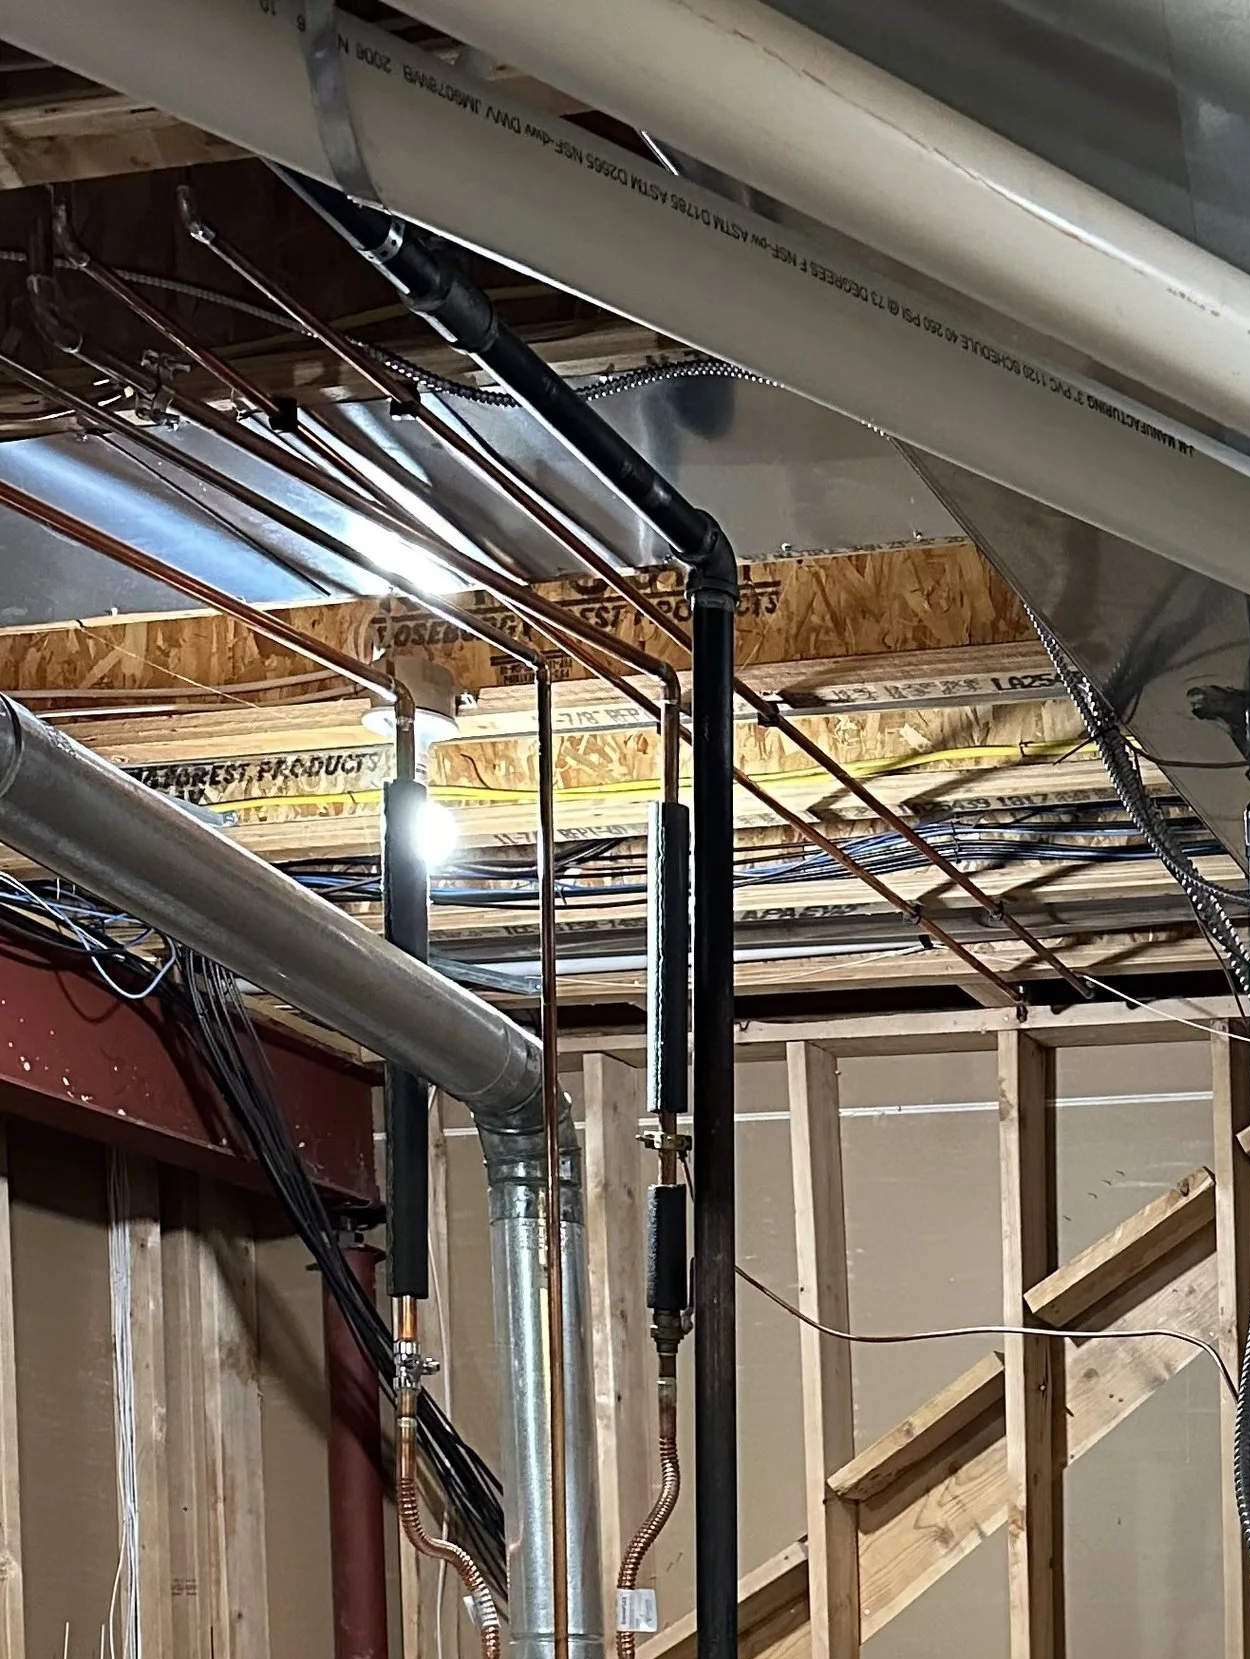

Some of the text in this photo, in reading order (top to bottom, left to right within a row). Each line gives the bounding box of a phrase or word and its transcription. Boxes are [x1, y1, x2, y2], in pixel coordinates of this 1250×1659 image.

[486, 105, 521, 135] DWV
[586, 154, 629, 186] D2665
[630, 173, 668, 204] ASTM
[671, 193, 711, 226] D1785
[713, 215, 749, 243] ASTM
[799, 258, 808, 272] F
[810, 259, 869, 300] DEGREES
[870, 292, 886, 309] 73
[901, 306, 921, 328] PSI
[960, 334, 1021, 375] SCHEDULE
[1022, 365, 1047, 386] 1120
[1050, 377, 1073, 400] PVC
[1087, 395, 1178, 448] MANUFACTURING
[257, 753, 380, 782] PRODUCTS
